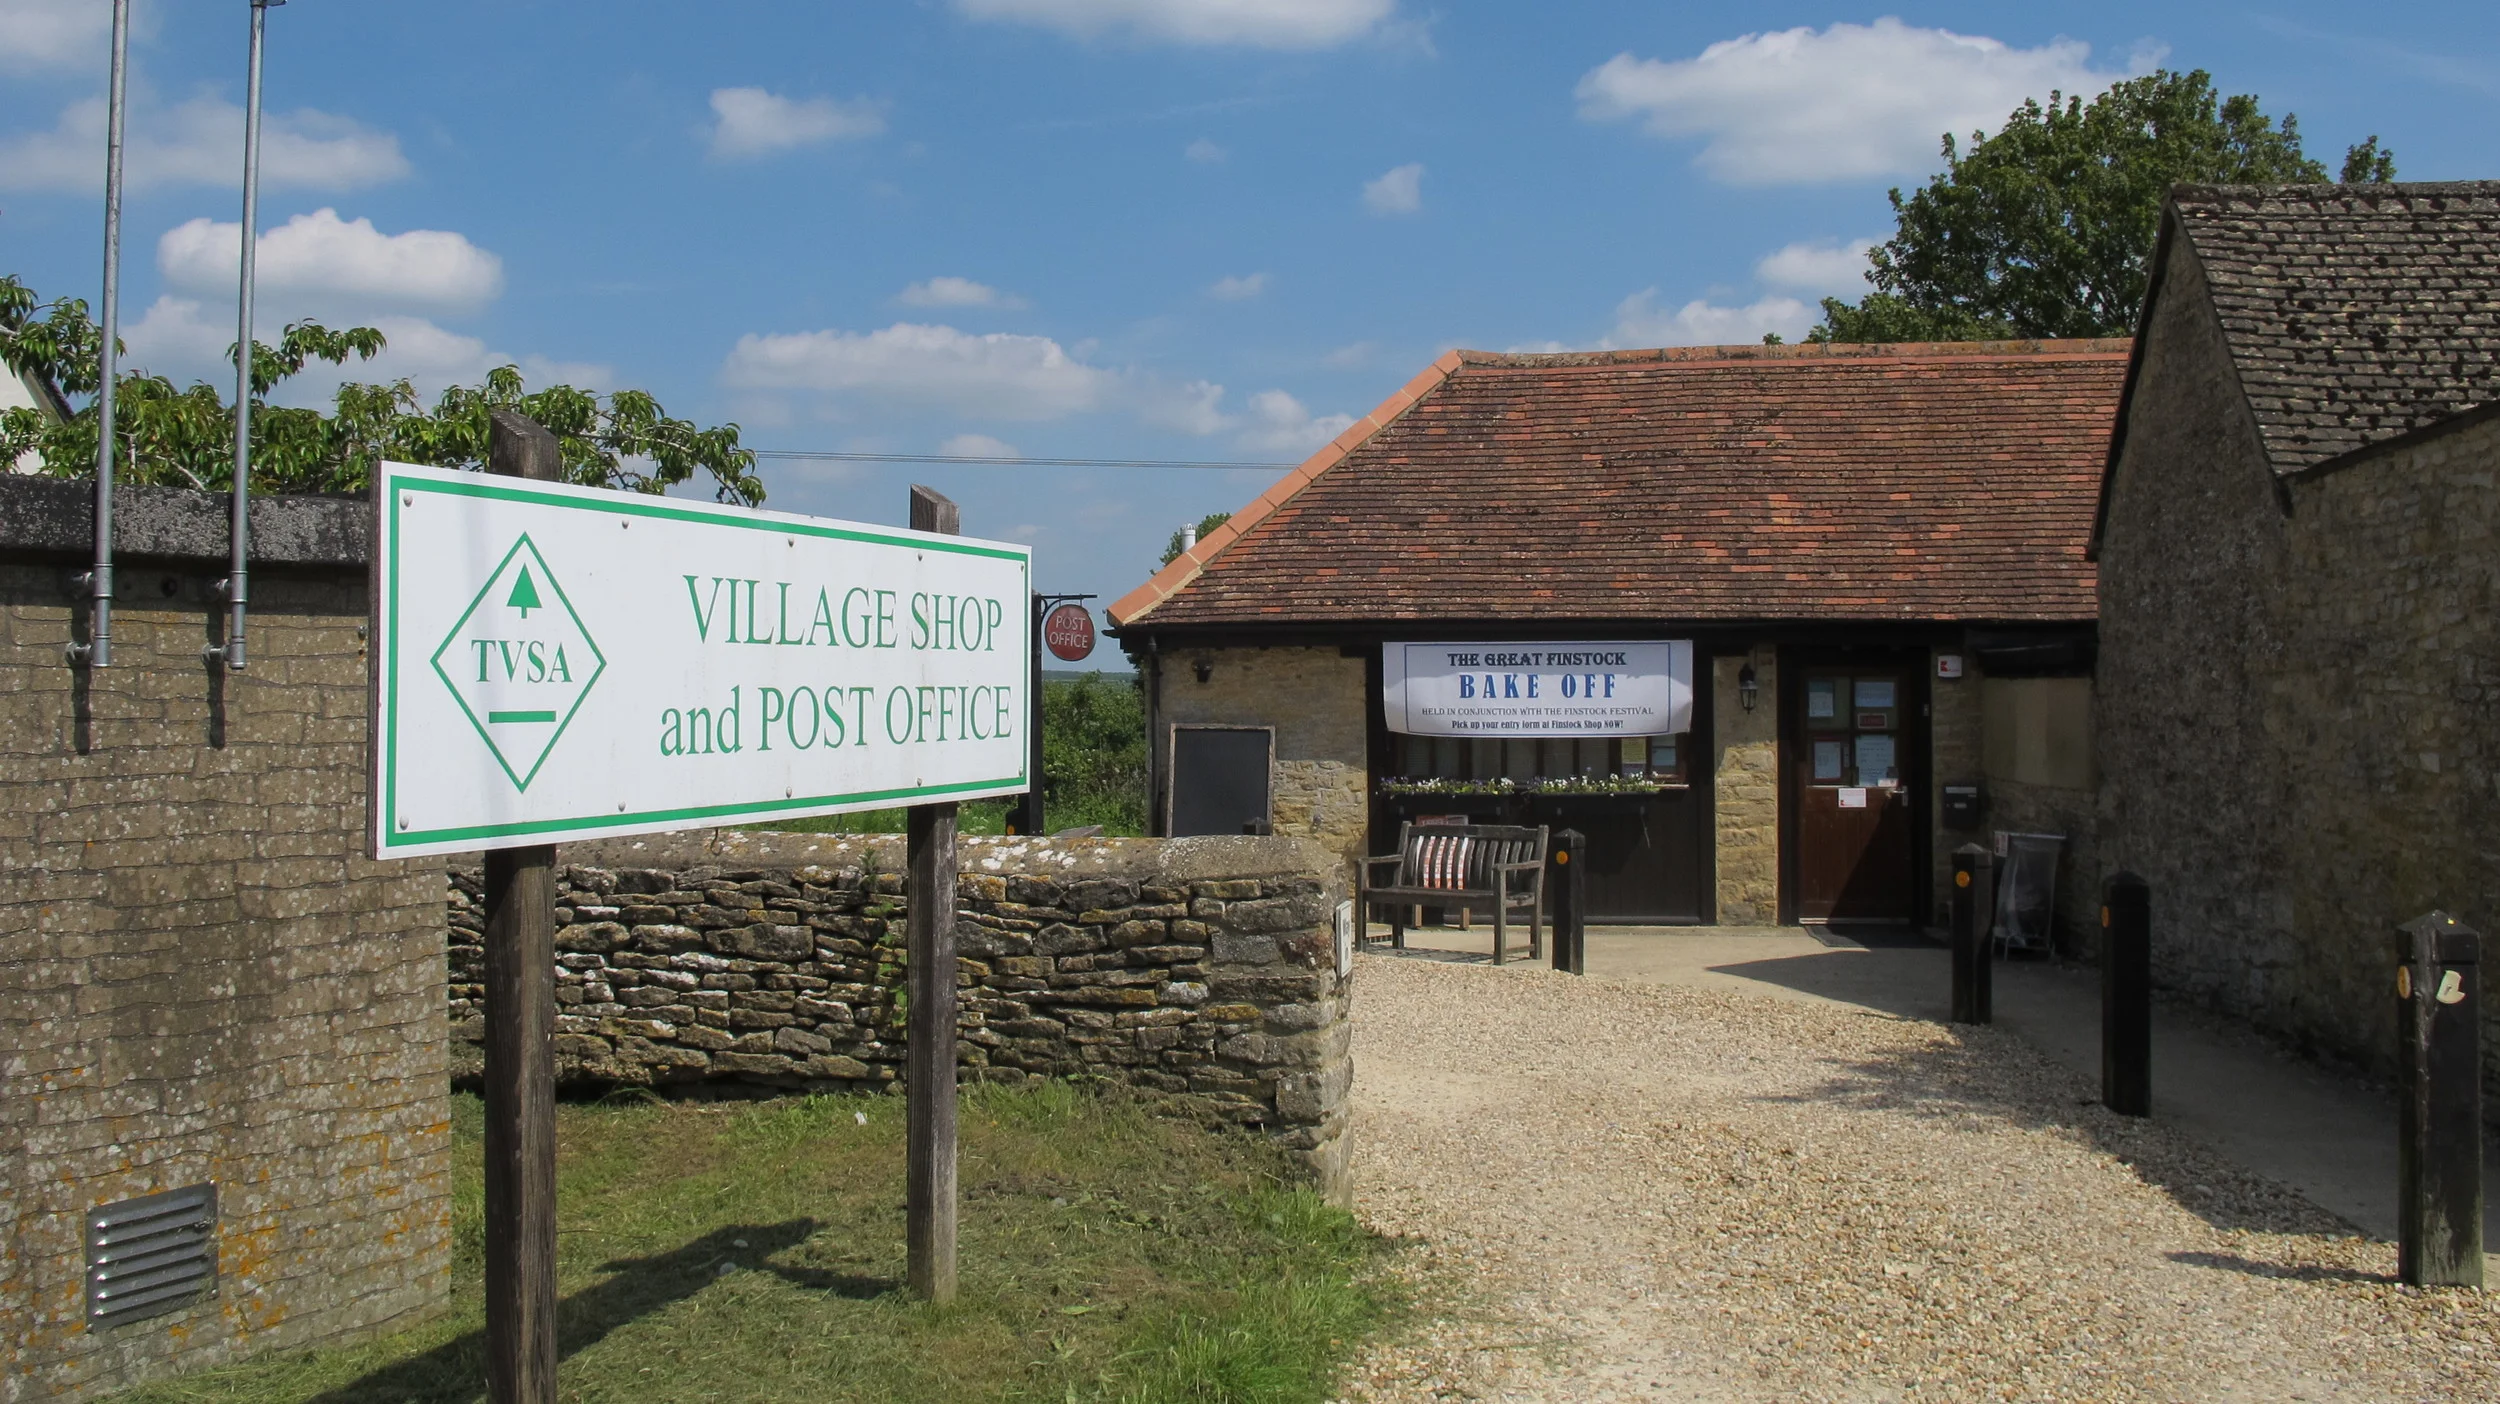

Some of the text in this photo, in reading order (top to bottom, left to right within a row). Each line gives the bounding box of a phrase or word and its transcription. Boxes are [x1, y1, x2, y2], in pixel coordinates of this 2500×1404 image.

[682, 574, 1004, 652] VILLAGE SHOP
[1055, 615, 1086, 631] POST
[1049, 632, 1088, 648] OFFICE
[470, 638, 574, 685] TVSA
[1447, 652, 1627, 667] THE GREAT FINSTOCK
[1459, 673, 1616, 698] BAKE OFF
[1422, 706, 1654, 716] HELD IN CONJUNCTION WITH THE FINSTOCK FESTIVAL
[660, 685, 1013, 757] and POST OFFICE
[1452, 720, 1469, 729] Pick
[1470, 721, 1480, 730] up
[1482, 721, 1499, 730] your
[1501, 721, 1520, 730] entry
[1522, 720, 1540, 729] form
[1551, 720, 1582, 729] Finstock
[1584, 720, 1602, 730] Shop
[1604, 720, 1624, 729] NOW!
